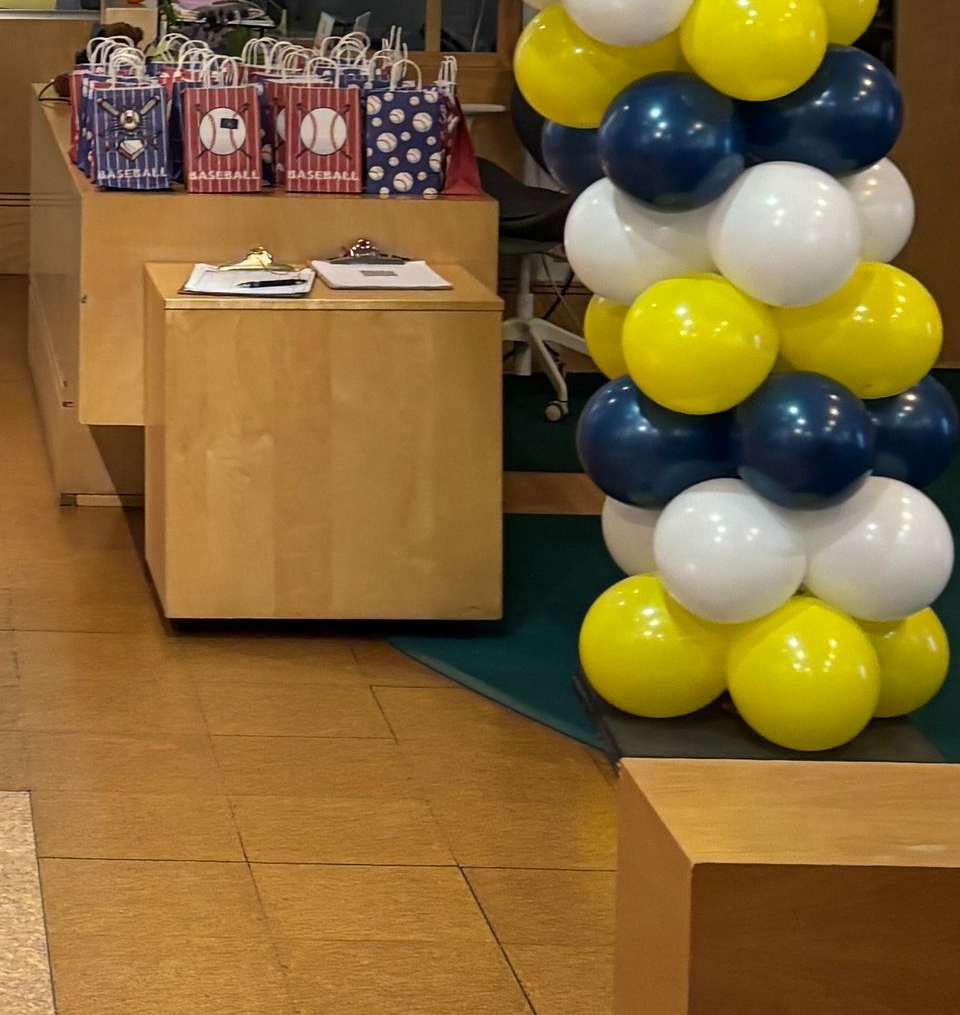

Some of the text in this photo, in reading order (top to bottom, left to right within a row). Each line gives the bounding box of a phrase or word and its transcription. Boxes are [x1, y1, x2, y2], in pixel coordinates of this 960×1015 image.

[97, 167, 167, 180] BASEBALL
[189, 170, 261, 180] BASEBALL
[287, 170, 359, 181] BASEBALL
